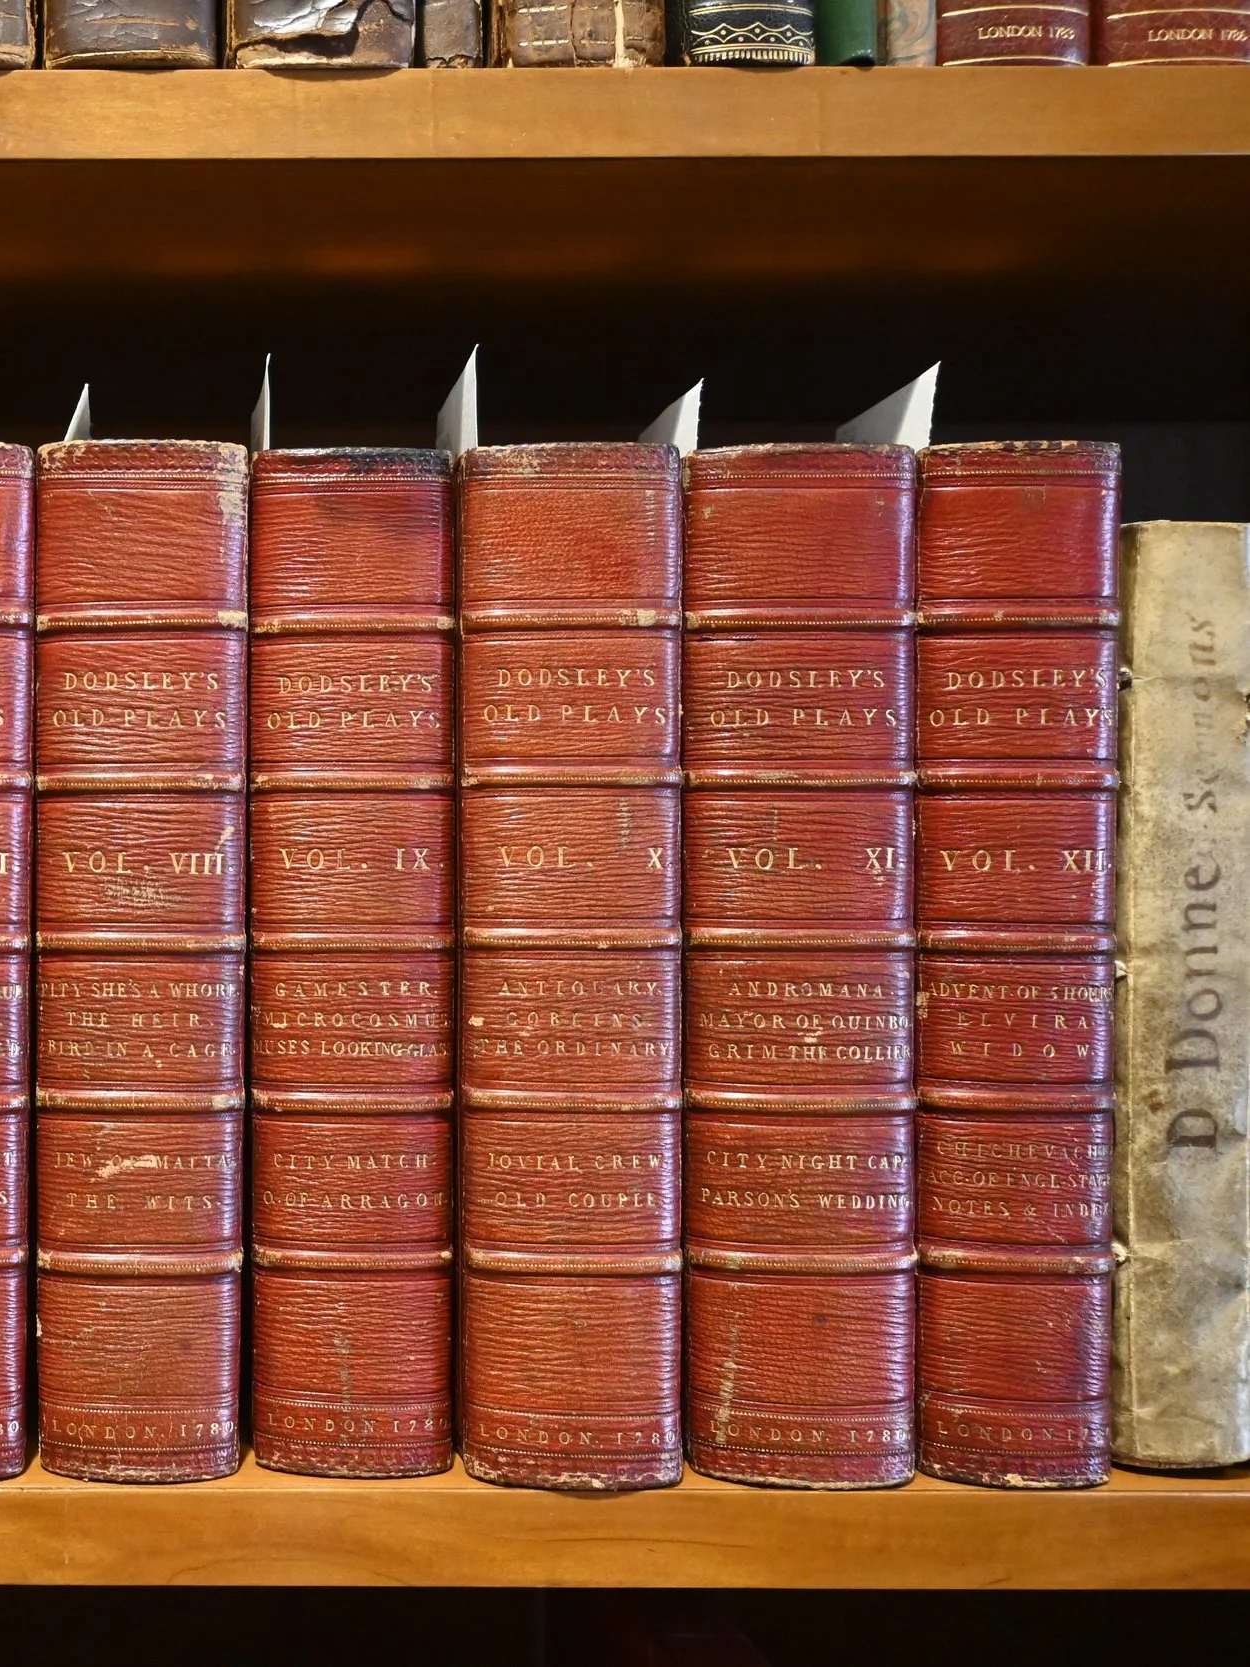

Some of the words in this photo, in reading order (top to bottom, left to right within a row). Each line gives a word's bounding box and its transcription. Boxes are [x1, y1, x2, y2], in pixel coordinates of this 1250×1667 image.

[978, 26, 1043, 40] LONDON
[1147, 29, 1214, 42] LONDON
[64, 671, 219, 690] DODSLEY'S
[278, 674, 434, 694] DODSLEY'S
[498, 668, 656, 687] DODSLEY'S
[727, 670, 885, 689] DODSLEY'S
[946, 669, 1107, 690] DODSLEY'S
[53, 709, 104, 728] OLD
[124, 709, 226, 728] PLAYS
[267, 712, 321, 729] OLD
[341, 710, 440, 728] PLAYS
[483, 704, 542, 723] OLD
[561, 704, 666, 724] PLAYS
[710, 709, 770, 727] OLD
[792, 708, 898, 727] PLAYS
[930, 708, 991, 727] OLD
[1016, 708, 1114, 727] PLAYS
[62, 851, 149, 874] VOL.
[279, 848, 369, 870] VOL.
[498, 846, 594, 868] VOL.
[726, 848, 822, 870] VOL.
[940, 850, 1036, 873] VOL.
[1165, 858, 1222, 1074] Donne
[41, 982, 83, 998] PITY
[92, 979, 141, 998] SHE'S
[149, 985, 160, 998] A
[275, 981, 438, 997] GAMESTER.
[728, 981, 895, 998] ANDROMANA.
[1017, 985, 1042, 999] OF
[1050, 986, 1059, 1000] 5
[66, 1011, 110, 1027] THE
[700, 1012, 786, 1029] MAYOR
[796, 1014, 824, 1030] OF
[957, 1011, 1095, 1029] ELVIRA.
[106, 1042, 128, 1056] IN
[142, 1044, 154, 1057] A
[477, 1038, 524, 1054] THE
[708, 1044, 777, 1059] GRIM
[789, 1045, 827, 1060] THE
[836, 1046, 911, 1061] COLLIER
[1167, 1107, 1218, 1150] D
[55, 1152, 94, 1168] JEW
[274, 1153, 334, 1169] CITY
[707, 1151, 768, 1169] CITY
[781, 1155, 858, 1170] NIGHT
[973, 1171, 998, 1187] OF
[67, 1192, 117, 1209] THE
[145, 1194, 221, 1209] WITS.
[286, 1191, 310, 1207] OF
[495, 1192, 547, 1208] OLD
[701, 1187, 800, 1209] PARSON'S
[933, 1197, 1009, 1217] NOTES
[1024, 1202, 1037, 1217] &
[52, 1419, 165, 1440] LONDON.
[268, 1413, 384, 1433] LONDON.
[710, 1420, 829, 1443] LONDON.
[936, 1420, 1054, 1443] LONDON
[480, 1424, 599, 1445] LONDON.
